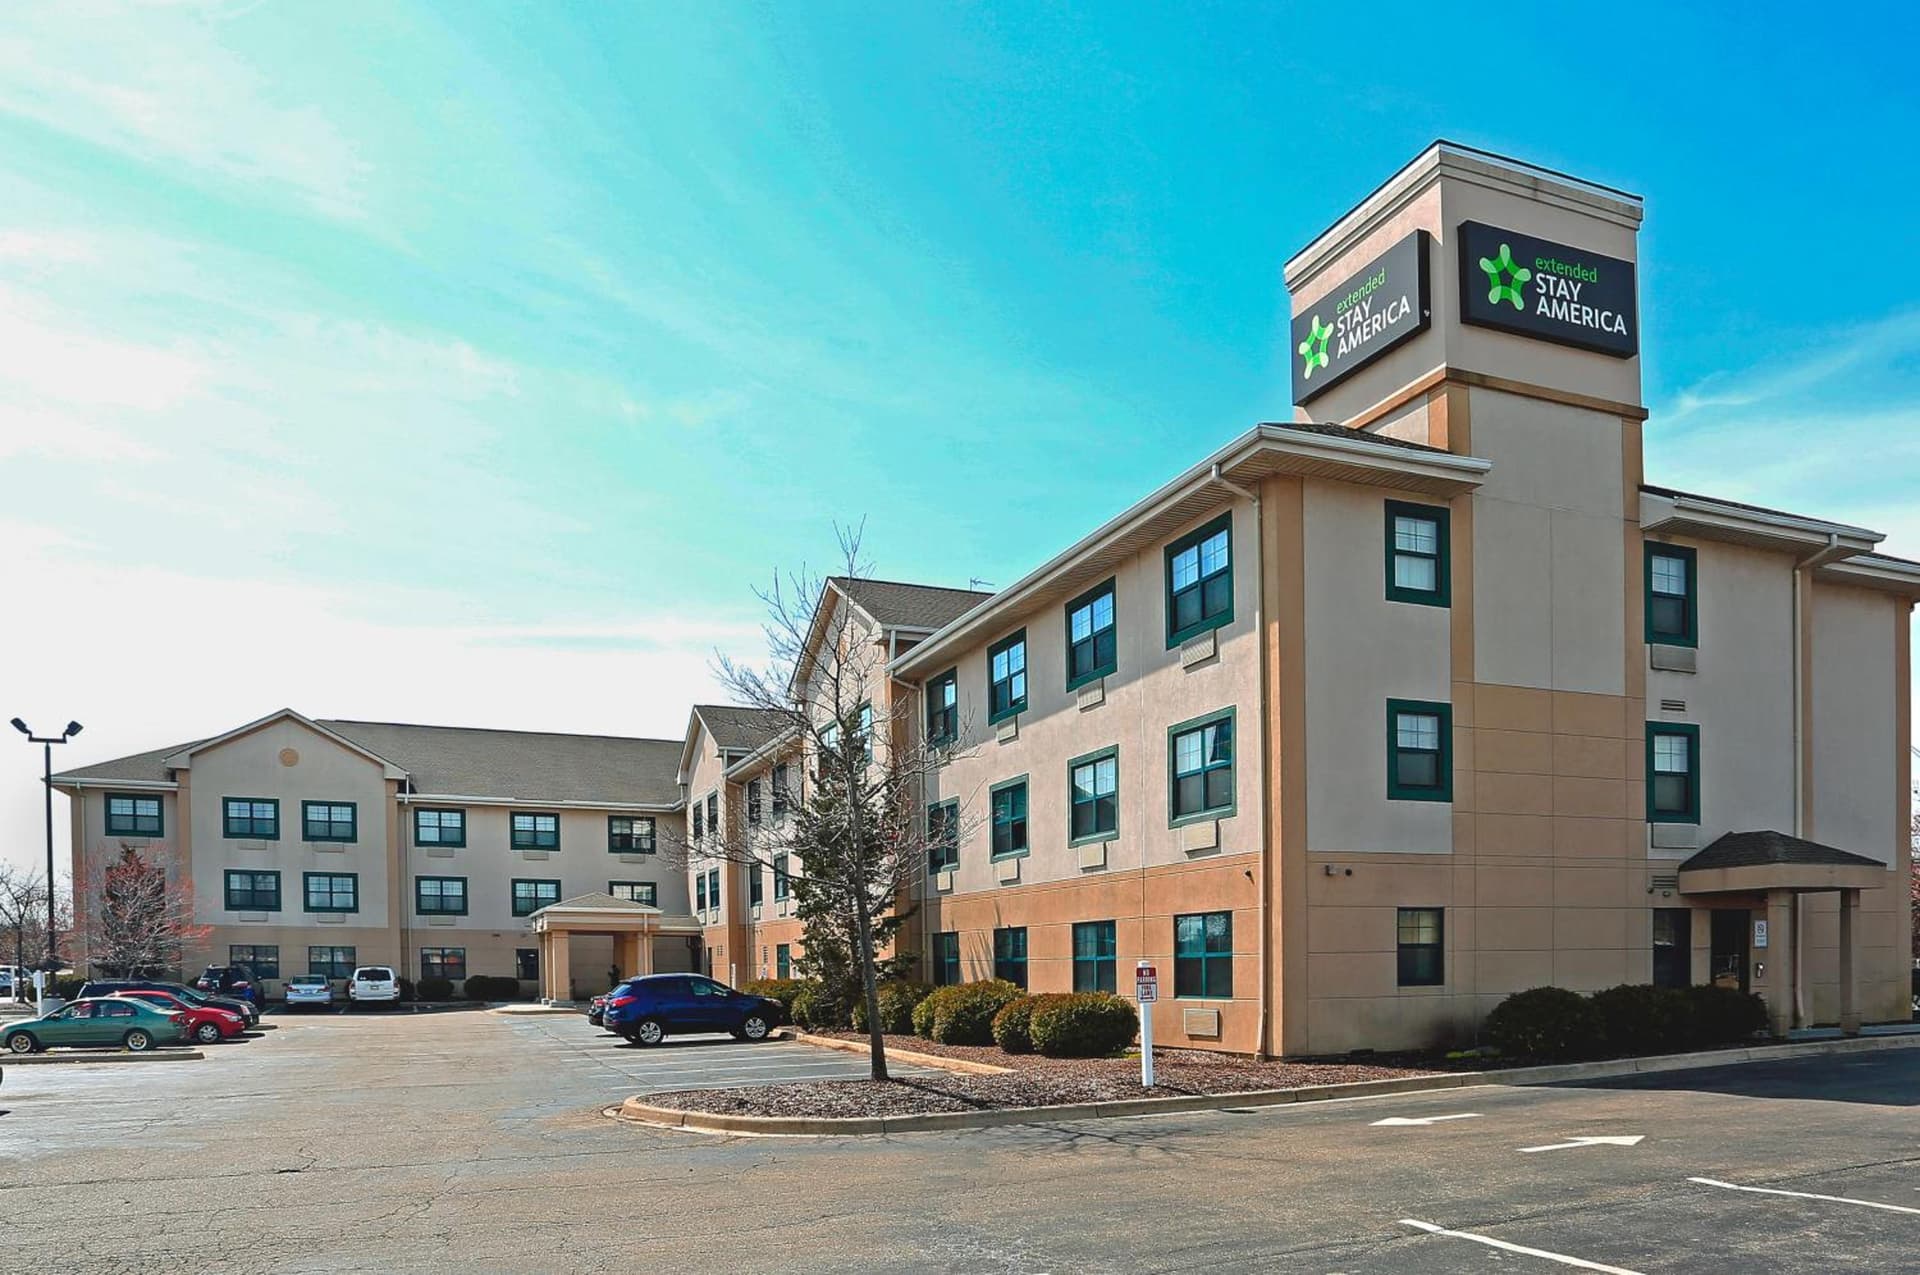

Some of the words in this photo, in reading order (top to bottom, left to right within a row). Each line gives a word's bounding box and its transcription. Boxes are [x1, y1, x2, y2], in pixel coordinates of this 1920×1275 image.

[1535, 256, 1597, 283] extended
[1536, 272, 1582, 302] STAY
[1336, 268, 1385, 313] extended
[1337, 296, 1373, 337] STAY
[1337, 295, 1411, 359] AMERICA
[1536, 296, 1628, 335] AMERICA
